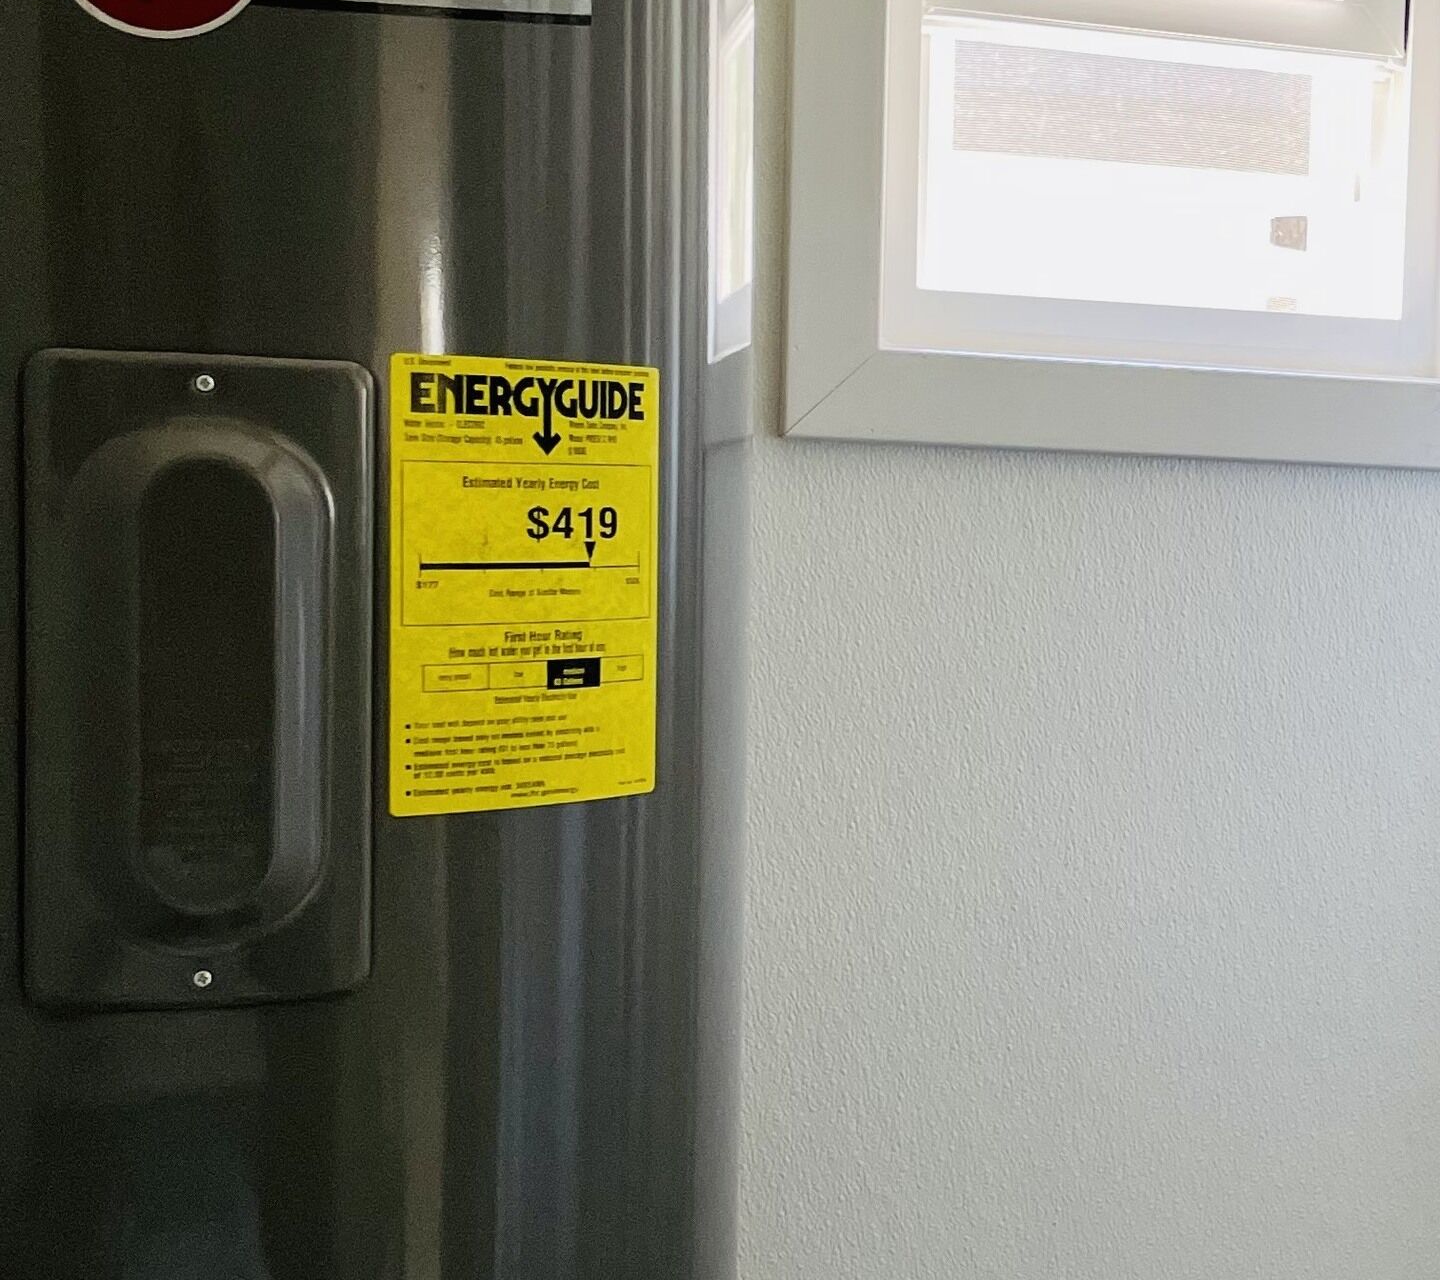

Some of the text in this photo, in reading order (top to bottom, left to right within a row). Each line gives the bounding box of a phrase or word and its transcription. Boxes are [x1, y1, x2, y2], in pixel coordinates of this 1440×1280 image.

[410, 371, 645, 421] ENERGYGUIDE
[462, 475, 600, 492] Estimated Yearly Energy Cost
[526, 505, 618, 544] $419
[504, 631, 526, 642] First
[529, 631, 551, 642] Hour
